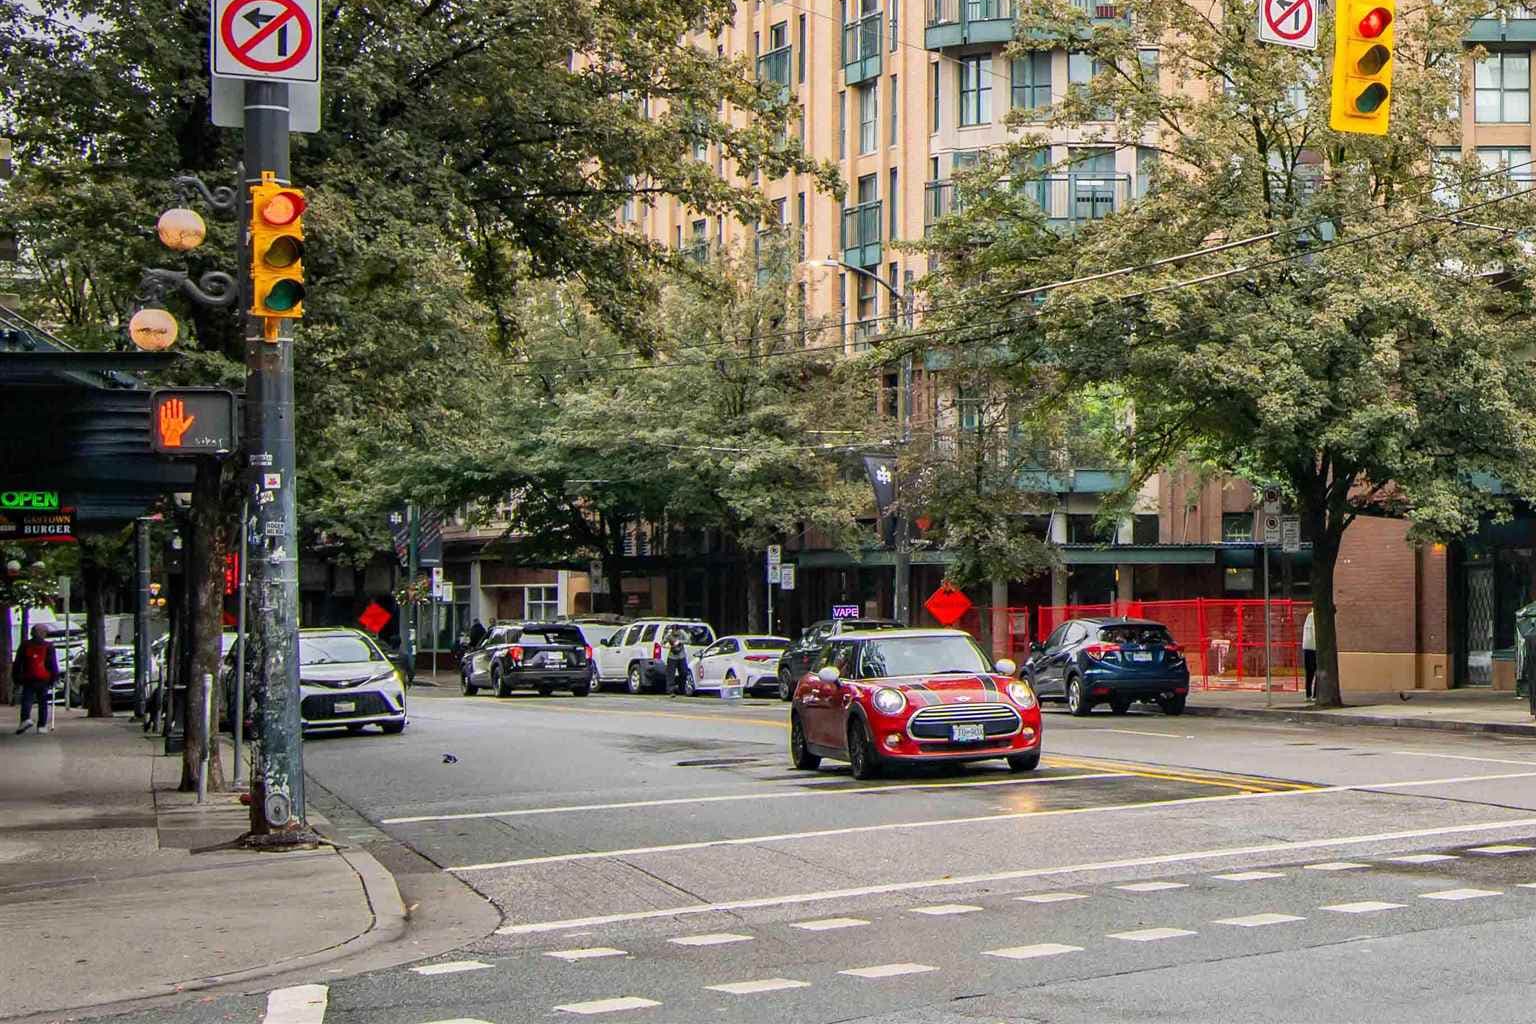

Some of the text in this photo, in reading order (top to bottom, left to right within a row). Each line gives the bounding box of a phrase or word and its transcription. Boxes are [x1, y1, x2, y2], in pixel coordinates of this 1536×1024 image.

[1, 491, 59, 507] OPEN
[24, 525, 71, 534] BURGER
[833, 607, 858, 617] VAPE
